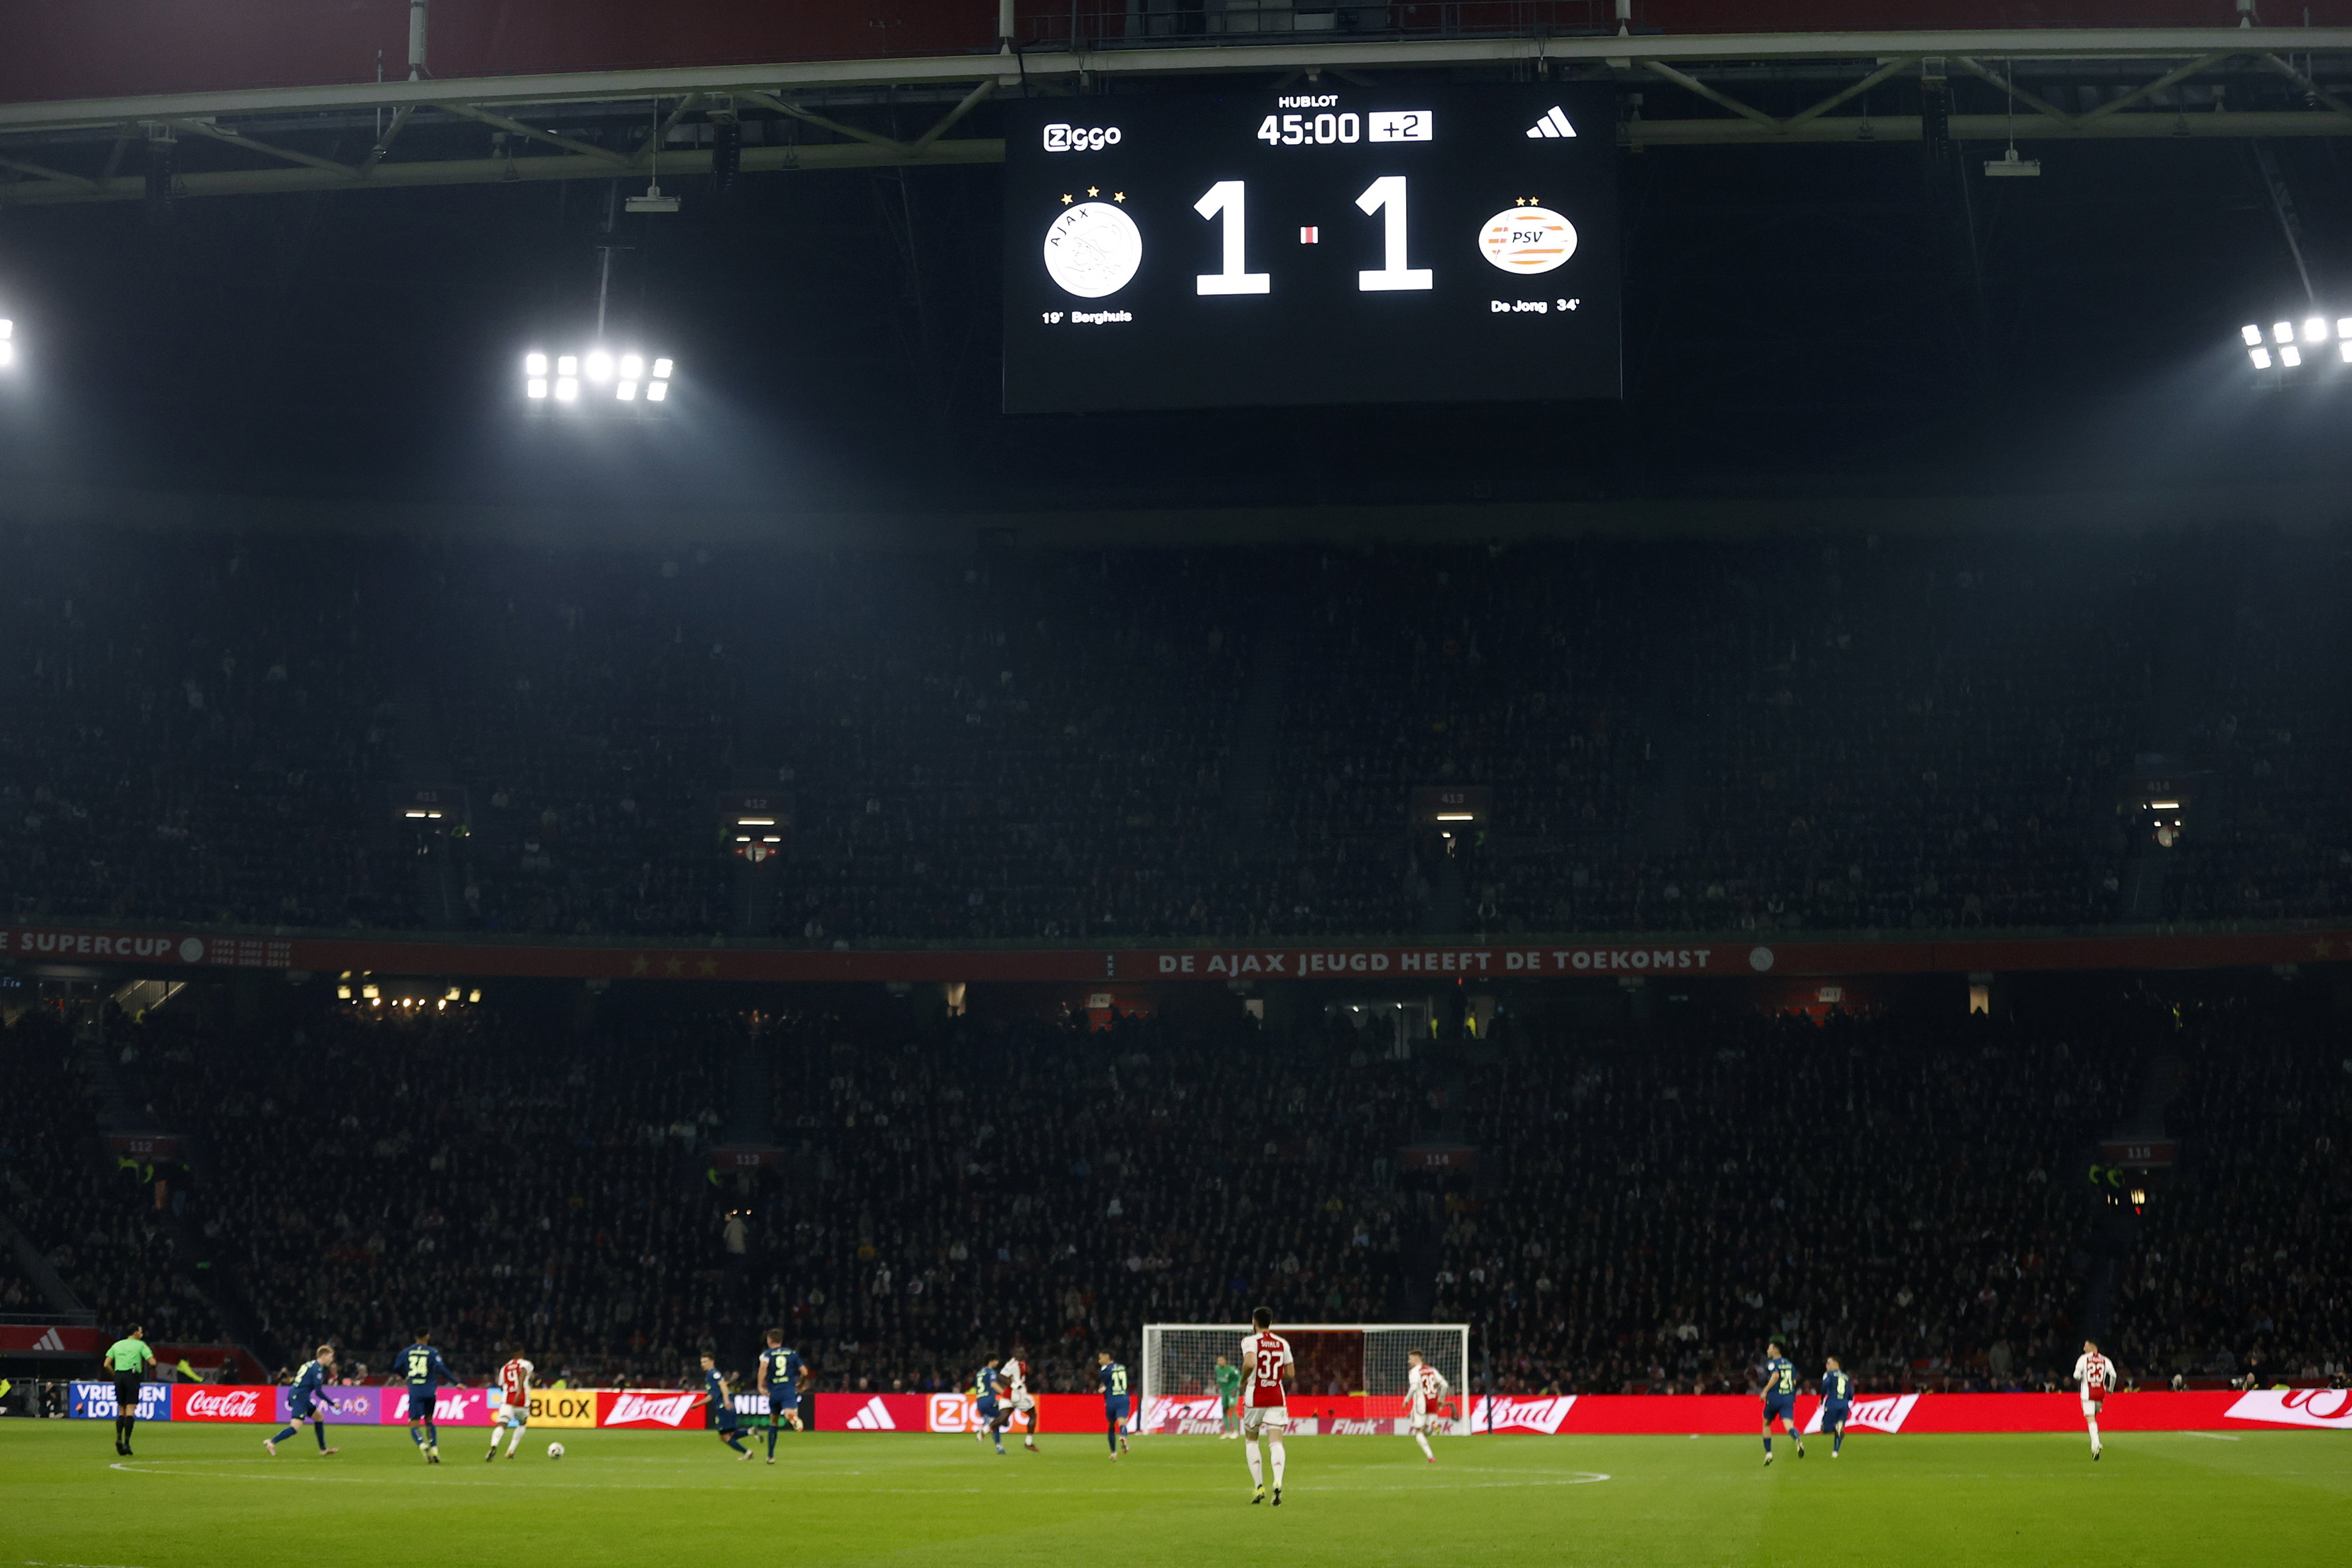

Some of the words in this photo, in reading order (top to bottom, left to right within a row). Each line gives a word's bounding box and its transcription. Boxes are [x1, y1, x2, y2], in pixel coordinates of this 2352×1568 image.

[1279, 95, 1338, 108] HUBLOT
[1258, 113, 1360, 145] 45:00
[1383, 115, 1419, 137] +2
[1051, 208, 1088, 246] AJAX
[1355, 176, 1433, 291] 1
[1194, 181, 1270, 295] 1
[1512, 232, 1543, 243] PSV
[1491, 300, 1511, 313] De
[1512, 300, 1548, 314] Jong
[1557, 299, 1580, 311] 34'
[1042, 312, 1063, 324] 19'
[1071, 310, 1133, 325] Berghuis
[1442, 793, 1464, 803] 413
[21, 932, 172, 957] SUPERCUP
[1159, 955, 1194, 973] DE
[1207, 955, 1285, 977] AJAX
[1297, 953, 1389, 977] JEUGD
[1401, 953, 1492, 971] HEEFT
[1506, 952, 1540, 971] DE
[1553, 950, 1711, 970] TOEKOMST
[130, 1142, 153, 1152] 112
[408, 1355, 428, 1377] 34
[775, 1356, 787, 1376] 9
[1258, 1350, 1284, 1380] 37
[2087, 1363, 2104, 1383] 23
[77, 1385, 166, 1402] VRIEEN
[88, 1401, 155, 1419] LOTRIJ
[394, 1393, 469, 1419] Fnk
[618, 1394, 681, 1419] Bud
[1478, 1396, 1560, 1425] Bud
[1176, 1418, 1224, 1434] Flink
[1330, 1419, 1377, 1435] Flink
